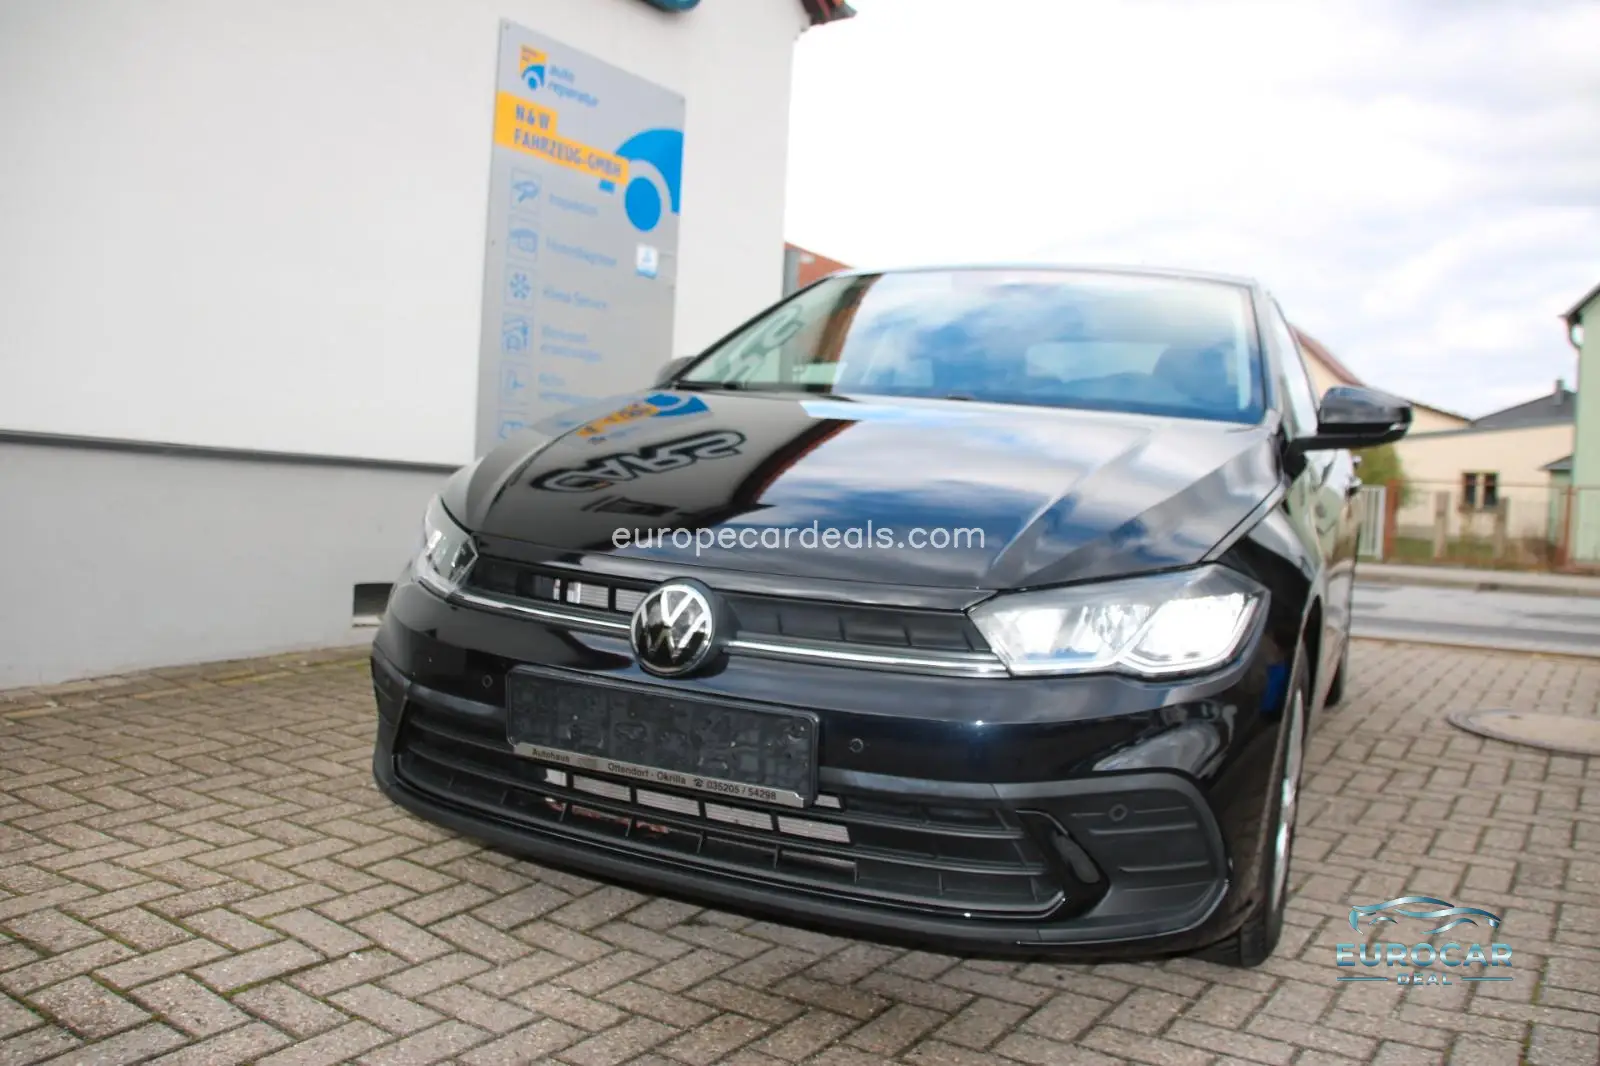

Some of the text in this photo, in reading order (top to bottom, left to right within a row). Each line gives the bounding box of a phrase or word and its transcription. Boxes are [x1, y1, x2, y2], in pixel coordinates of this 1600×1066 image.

[531, 747, 571, 763] Autohaus
[656, 770, 687, 785] Okrilla
[706, 780, 740, 794] 035205
[747, 786, 777, 801] 54298
